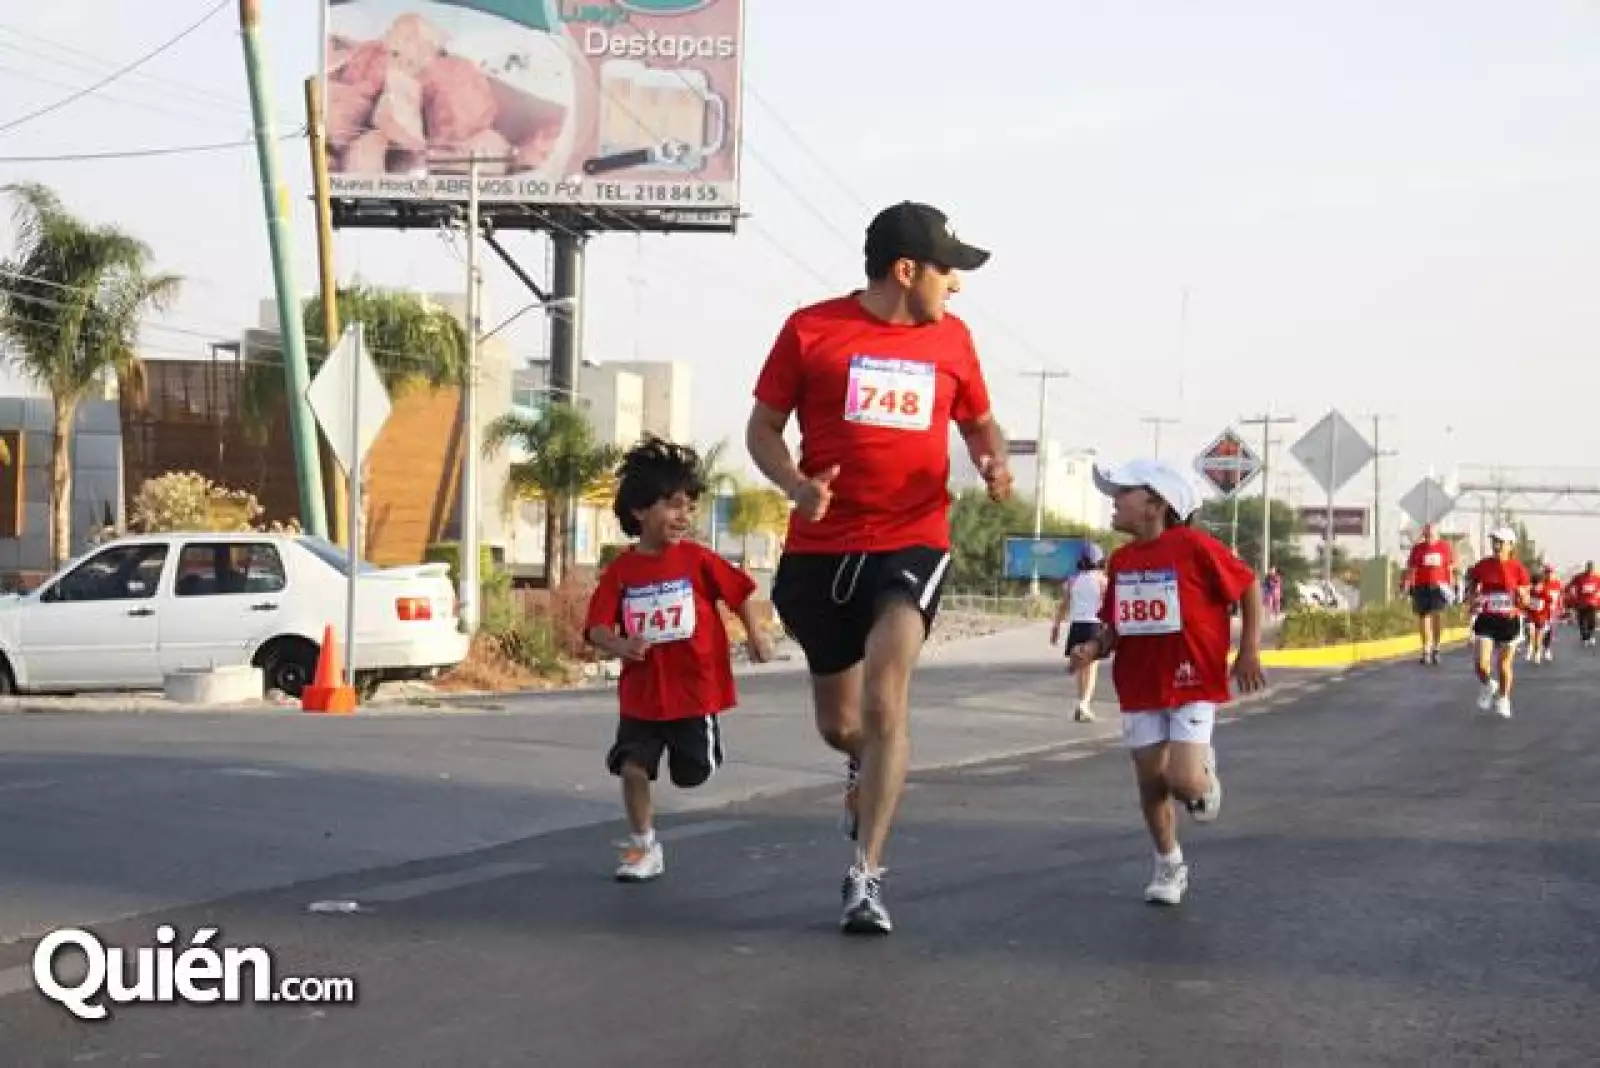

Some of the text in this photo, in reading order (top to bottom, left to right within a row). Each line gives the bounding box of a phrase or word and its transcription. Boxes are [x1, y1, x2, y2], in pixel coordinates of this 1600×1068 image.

[584, 26, 735, 61] Destapas
[596, 184, 631, 201] TEL.
[859, 385, 921, 416] 748
[627, 604, 683, 634] 747
